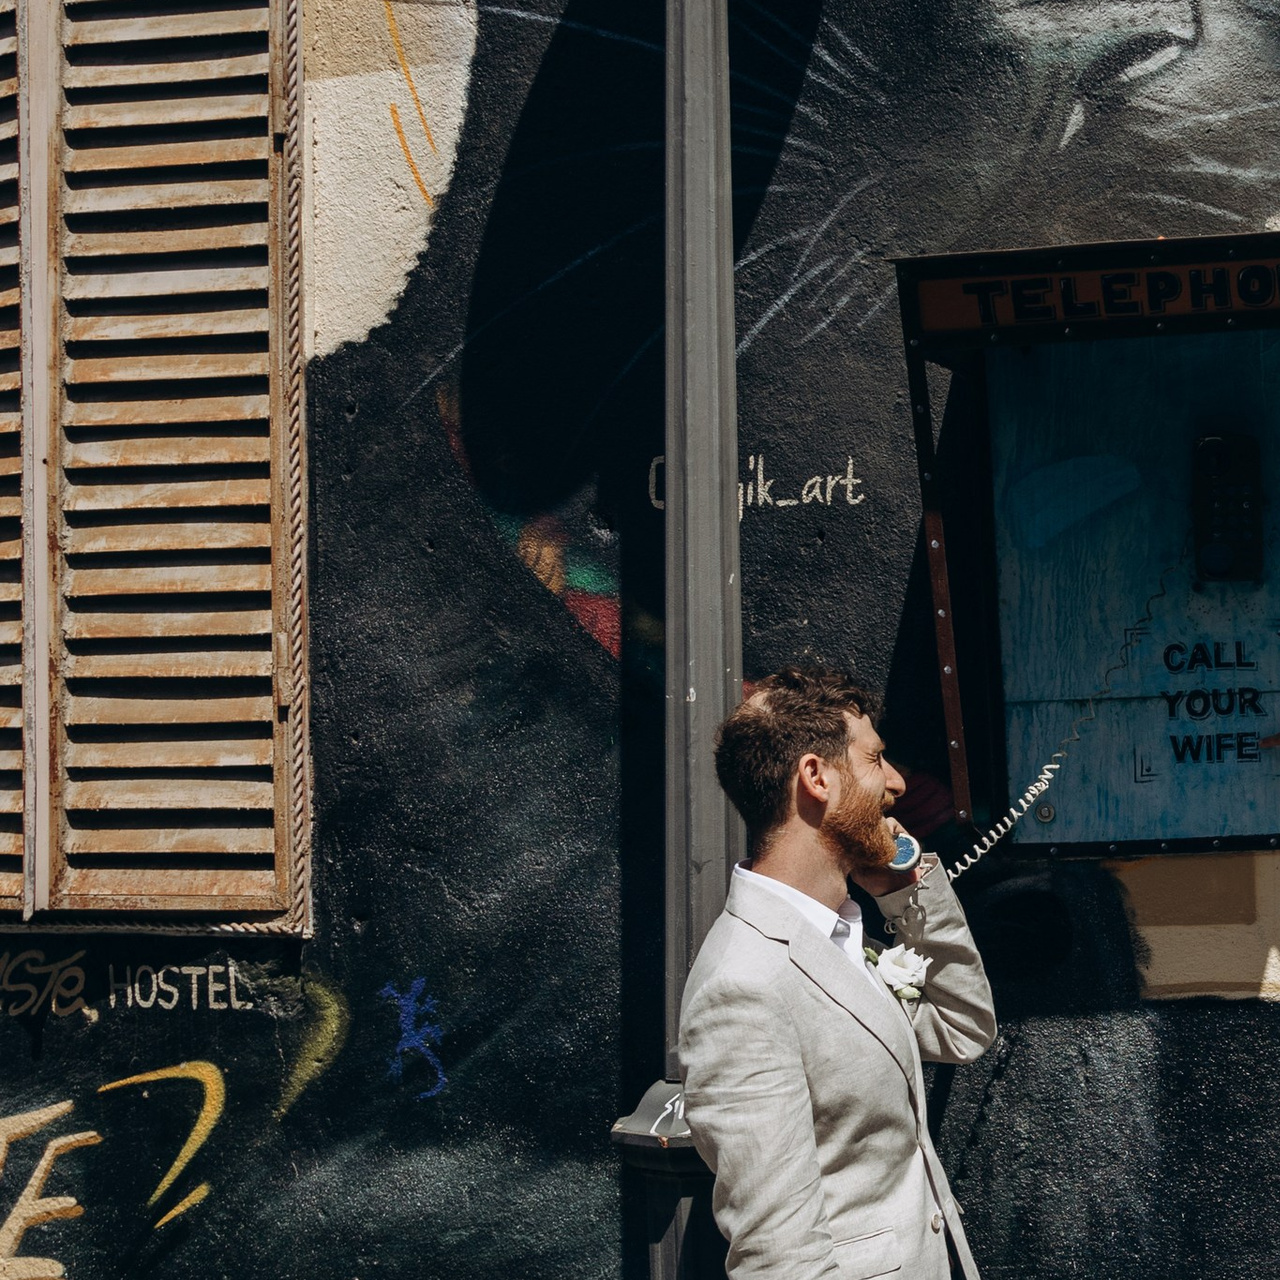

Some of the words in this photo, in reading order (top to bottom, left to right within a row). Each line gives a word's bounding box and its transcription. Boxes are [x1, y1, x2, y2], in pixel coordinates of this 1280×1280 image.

[1163, 640, 1258, 673] CALL
[1160, 686, 1268, 720] YOUR
[1169, 731, 1261, 764] WIFE
[109, 963, 254, 1010] HOSTEL
